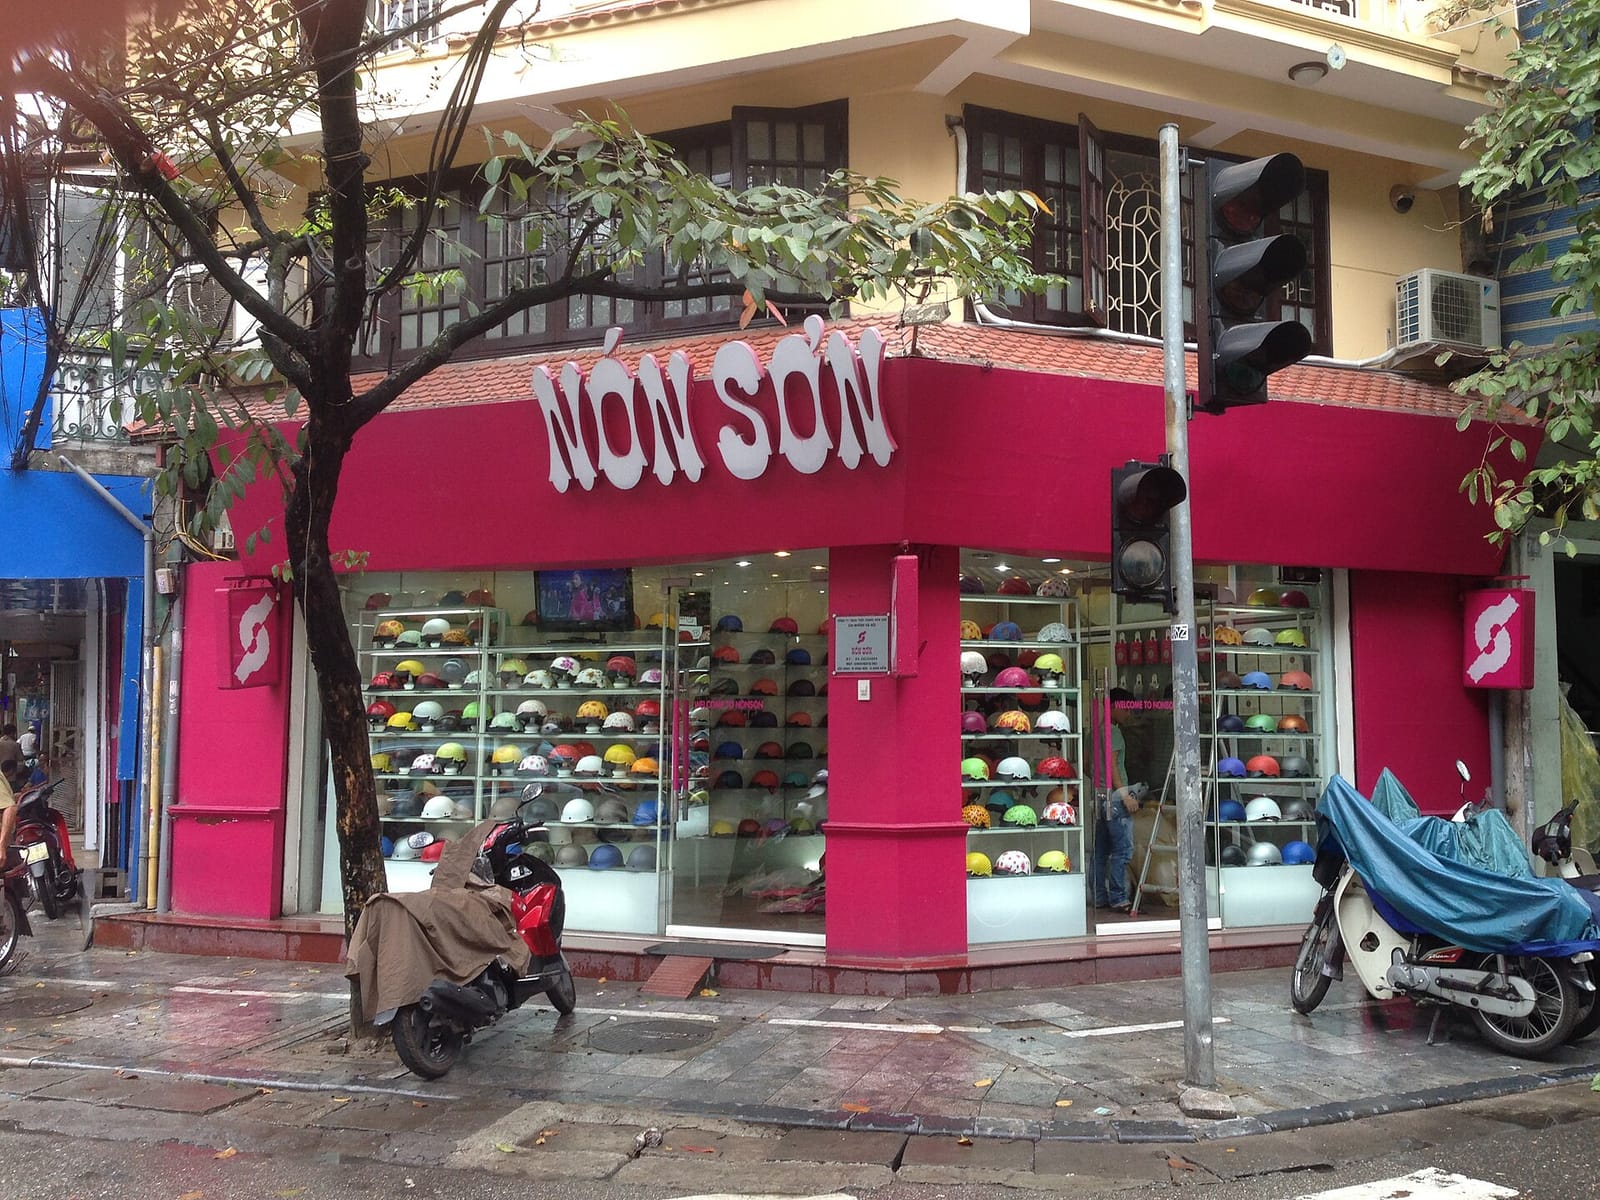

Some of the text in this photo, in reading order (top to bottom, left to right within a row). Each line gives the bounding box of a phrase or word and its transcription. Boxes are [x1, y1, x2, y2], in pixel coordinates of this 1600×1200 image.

[532, 327, 704, 493] NÓN
[1114, 700, 1174, 710] WELCOME TO NONSO
